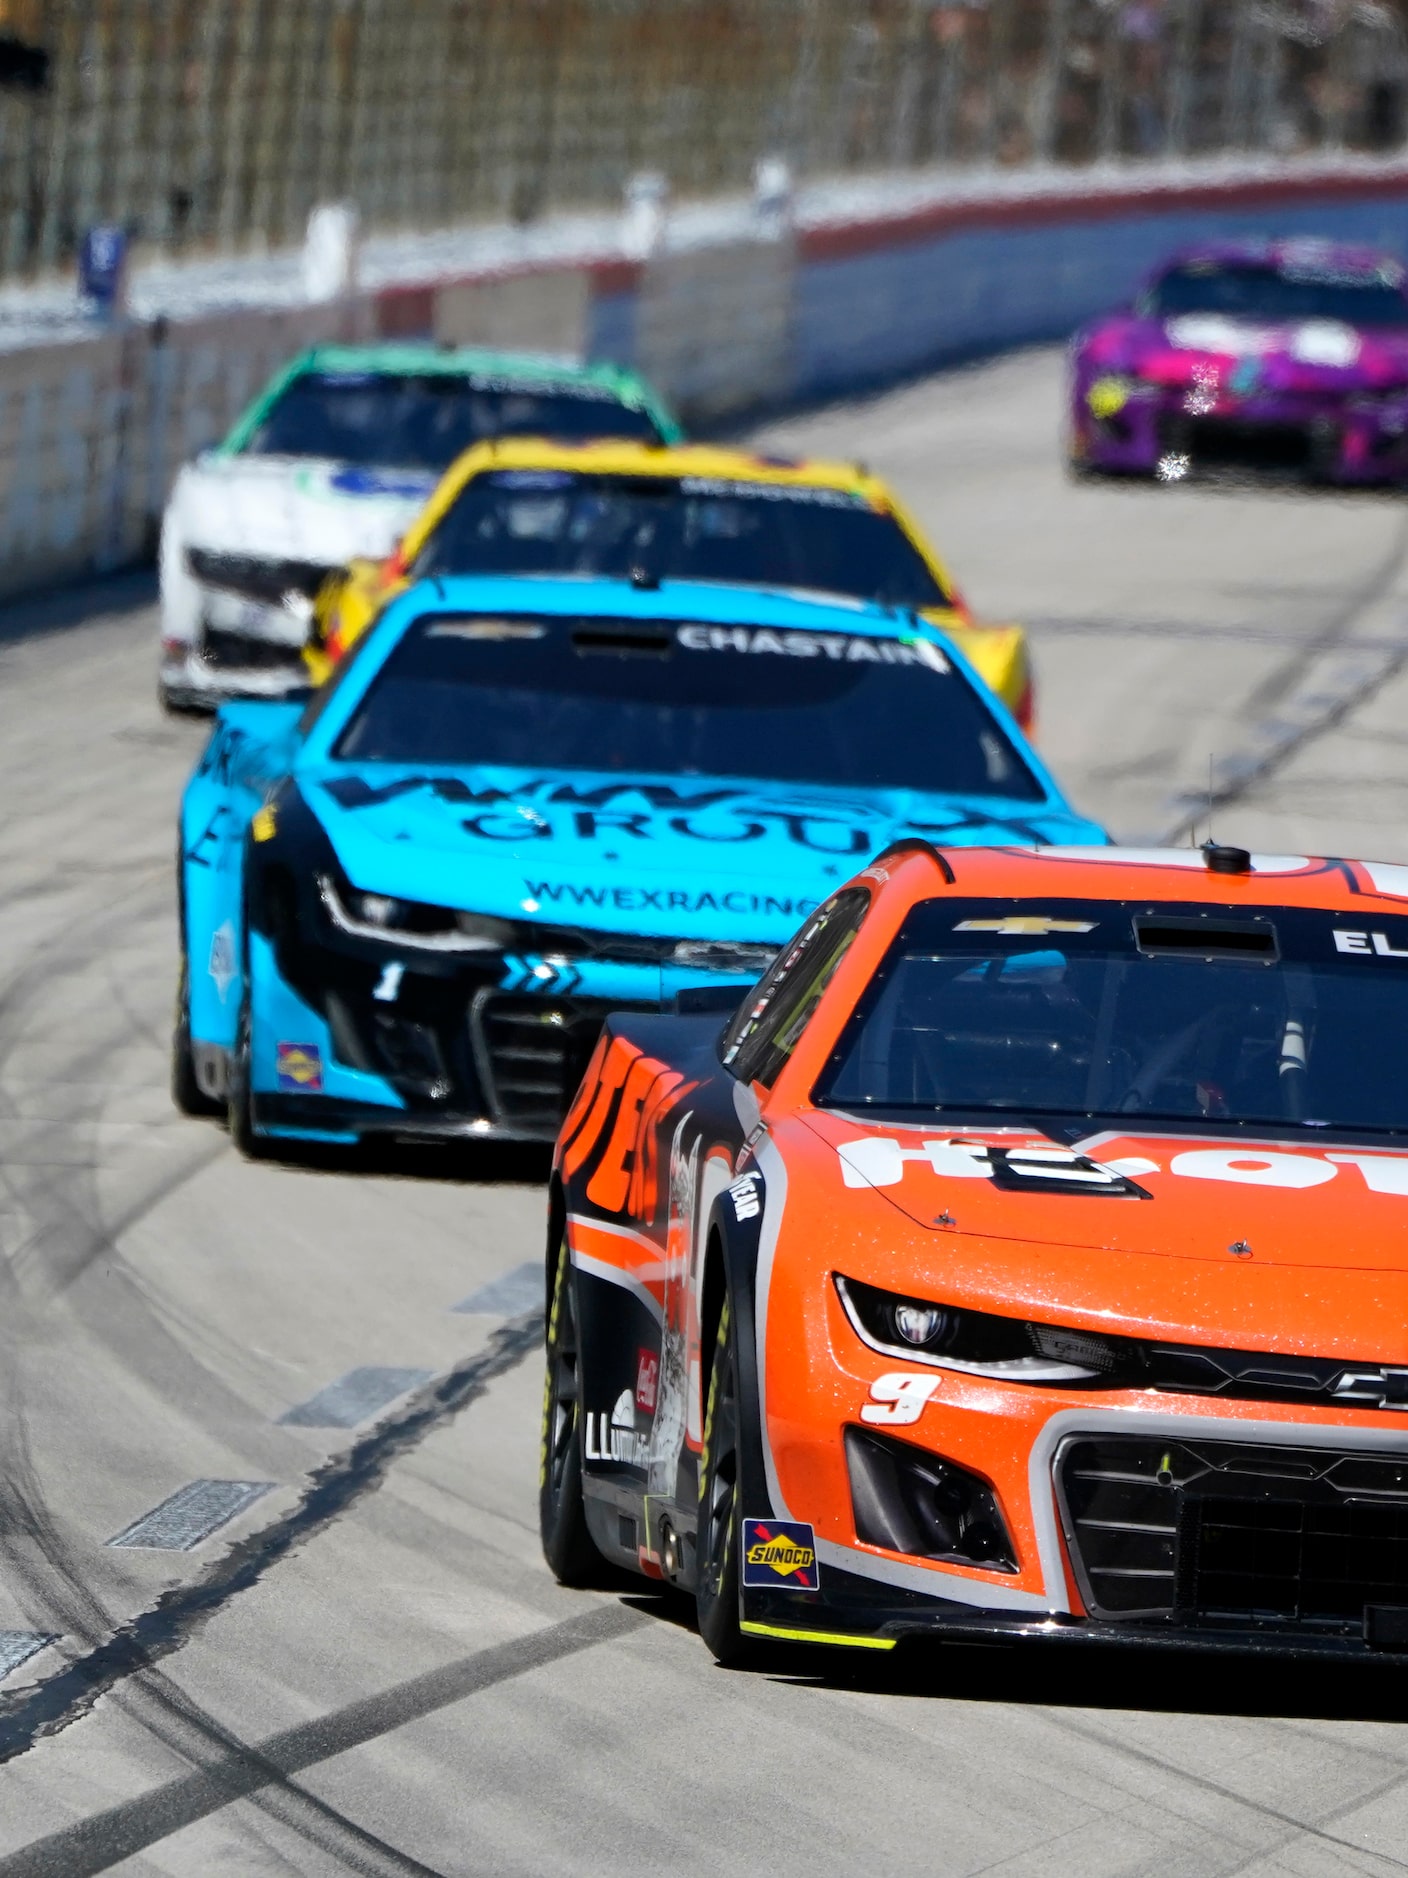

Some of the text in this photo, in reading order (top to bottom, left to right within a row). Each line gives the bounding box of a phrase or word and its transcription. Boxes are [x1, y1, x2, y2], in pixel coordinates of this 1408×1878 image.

[372, 960, 405, 1002] 1
[860, 1372, 942, 1425] 9
[751, 1546, 812, 1566] SUNOCO
